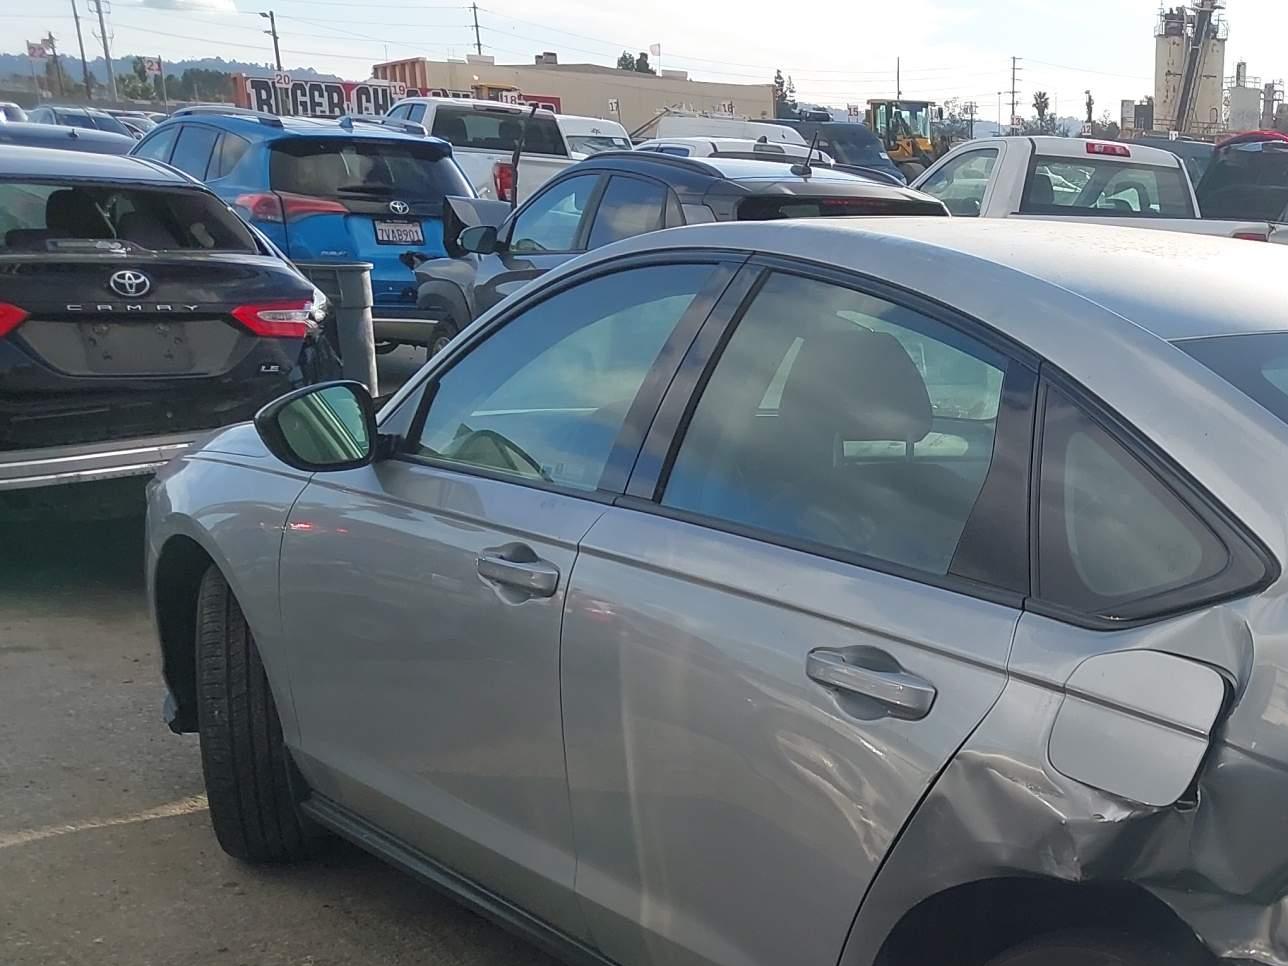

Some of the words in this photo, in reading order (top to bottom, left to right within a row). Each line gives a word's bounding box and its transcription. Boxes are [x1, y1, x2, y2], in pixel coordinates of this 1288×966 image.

[275, 73, 290, 85] 20
[392, 84, 405, 95] 19
[503, 94, 517, 104] 18
[847, 107, 859, 117] 15
[378, 228, 420, 241] 7VAB901
[66, 303, 199, 312] CAMRY
[260, 364, 280, 373] LE
